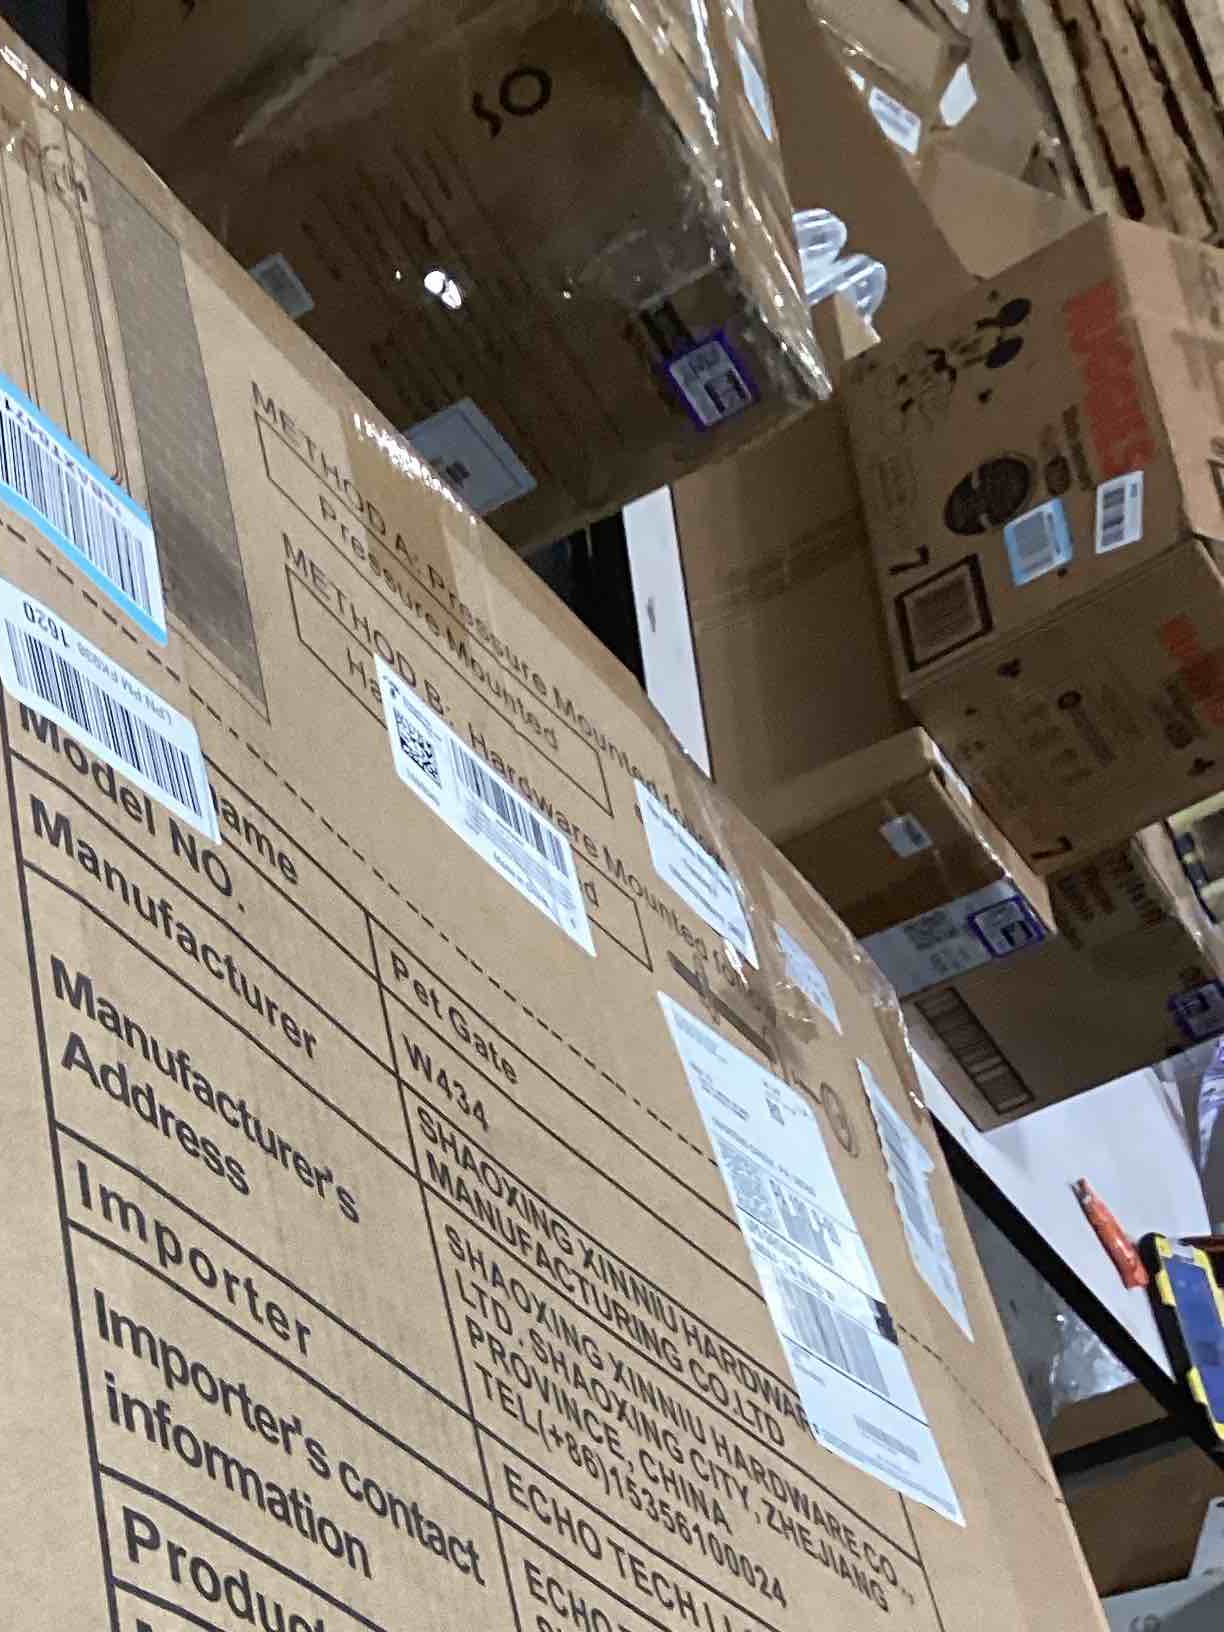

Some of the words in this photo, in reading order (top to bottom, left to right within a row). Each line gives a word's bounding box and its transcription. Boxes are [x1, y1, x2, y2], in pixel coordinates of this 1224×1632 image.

[251, 381, 385, 535] METHOD
[427, 564, 546, 696] Pressure
[319, 495, 440, 636] Pressure
[447, 627, 559, 751] Mounted
[19, 702, 155, 836] Model
[169, 816, 245, 913] NO.
[282, 532, 417, 688] METHOD
[603, 846, 708, 960] Mounted
[29, 793, 317, 1061] Manufacturer
[389, 950, 441, 1019] Pet
[448, 1004, 520, 1088] Gate
[51, 953, 361, 1225] Manufacturer's
[61, 1030, 250, 1197] Address
[400, 1032, 490, 1133] W434
[77, 1159, 311, 1357] Importer
[417, 1106, 573, 1256] SHAOXING
[578, 1238, 677, 1333] XINNIU
[681, 1314, 820, 1441] HARDWAR
[427, 1150, 684, 1373] MANUFACTURING
[94, 1287, 331, 1481] Importer's
[339, 1459, 485, 1588] contact
[104, 1371, 373, 1580] information
[445, 1224, 604, 1370] SHAOXING
[608, 1352, 706, 1445] XINNIU
[710, 1425, 861, 1559] HARDWARE
[639, 1449, 733, 1535] CHINA
[503, 1462, 602, 1560] ECHO
[606, 1536, 700, 1628] TECH
